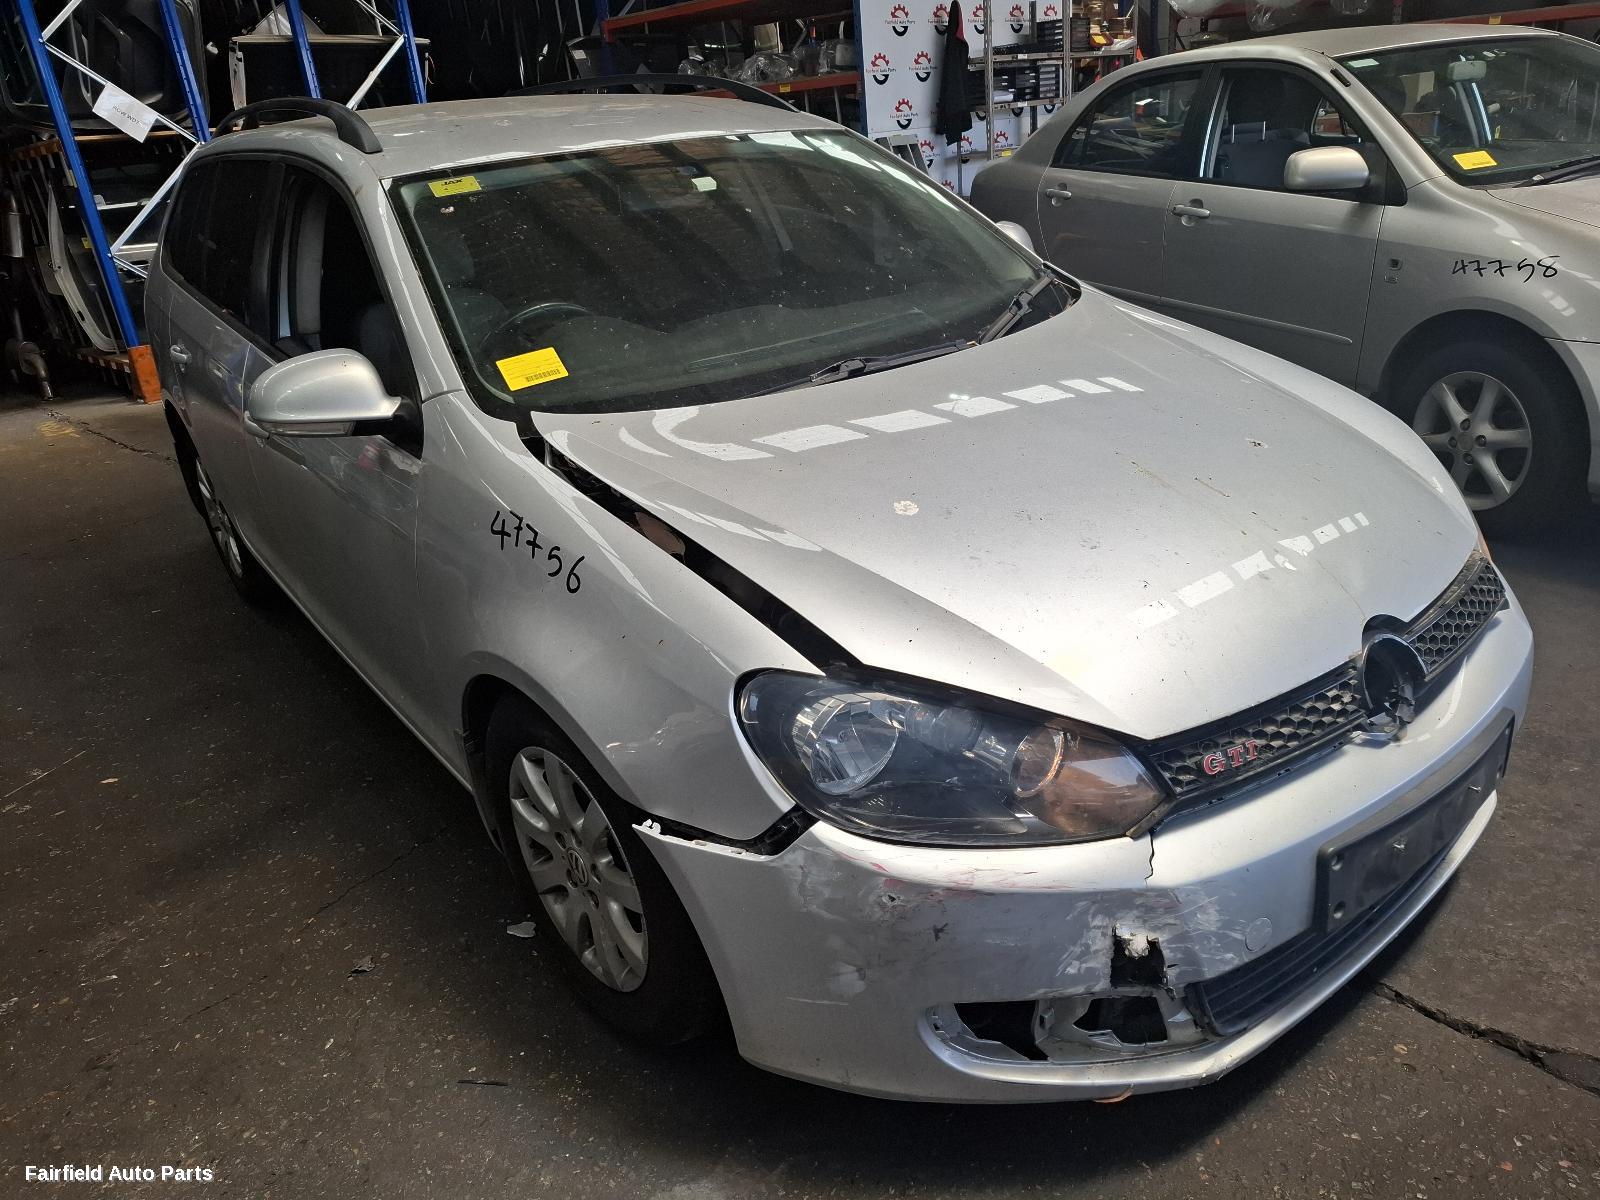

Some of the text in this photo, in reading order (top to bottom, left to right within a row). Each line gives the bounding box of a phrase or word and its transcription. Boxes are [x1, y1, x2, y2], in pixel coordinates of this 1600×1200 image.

[1452, 255, 1560, 283] 47758
[490, 510, 585, 594] 47756
[1203, 738, 1259, 776] GTI
